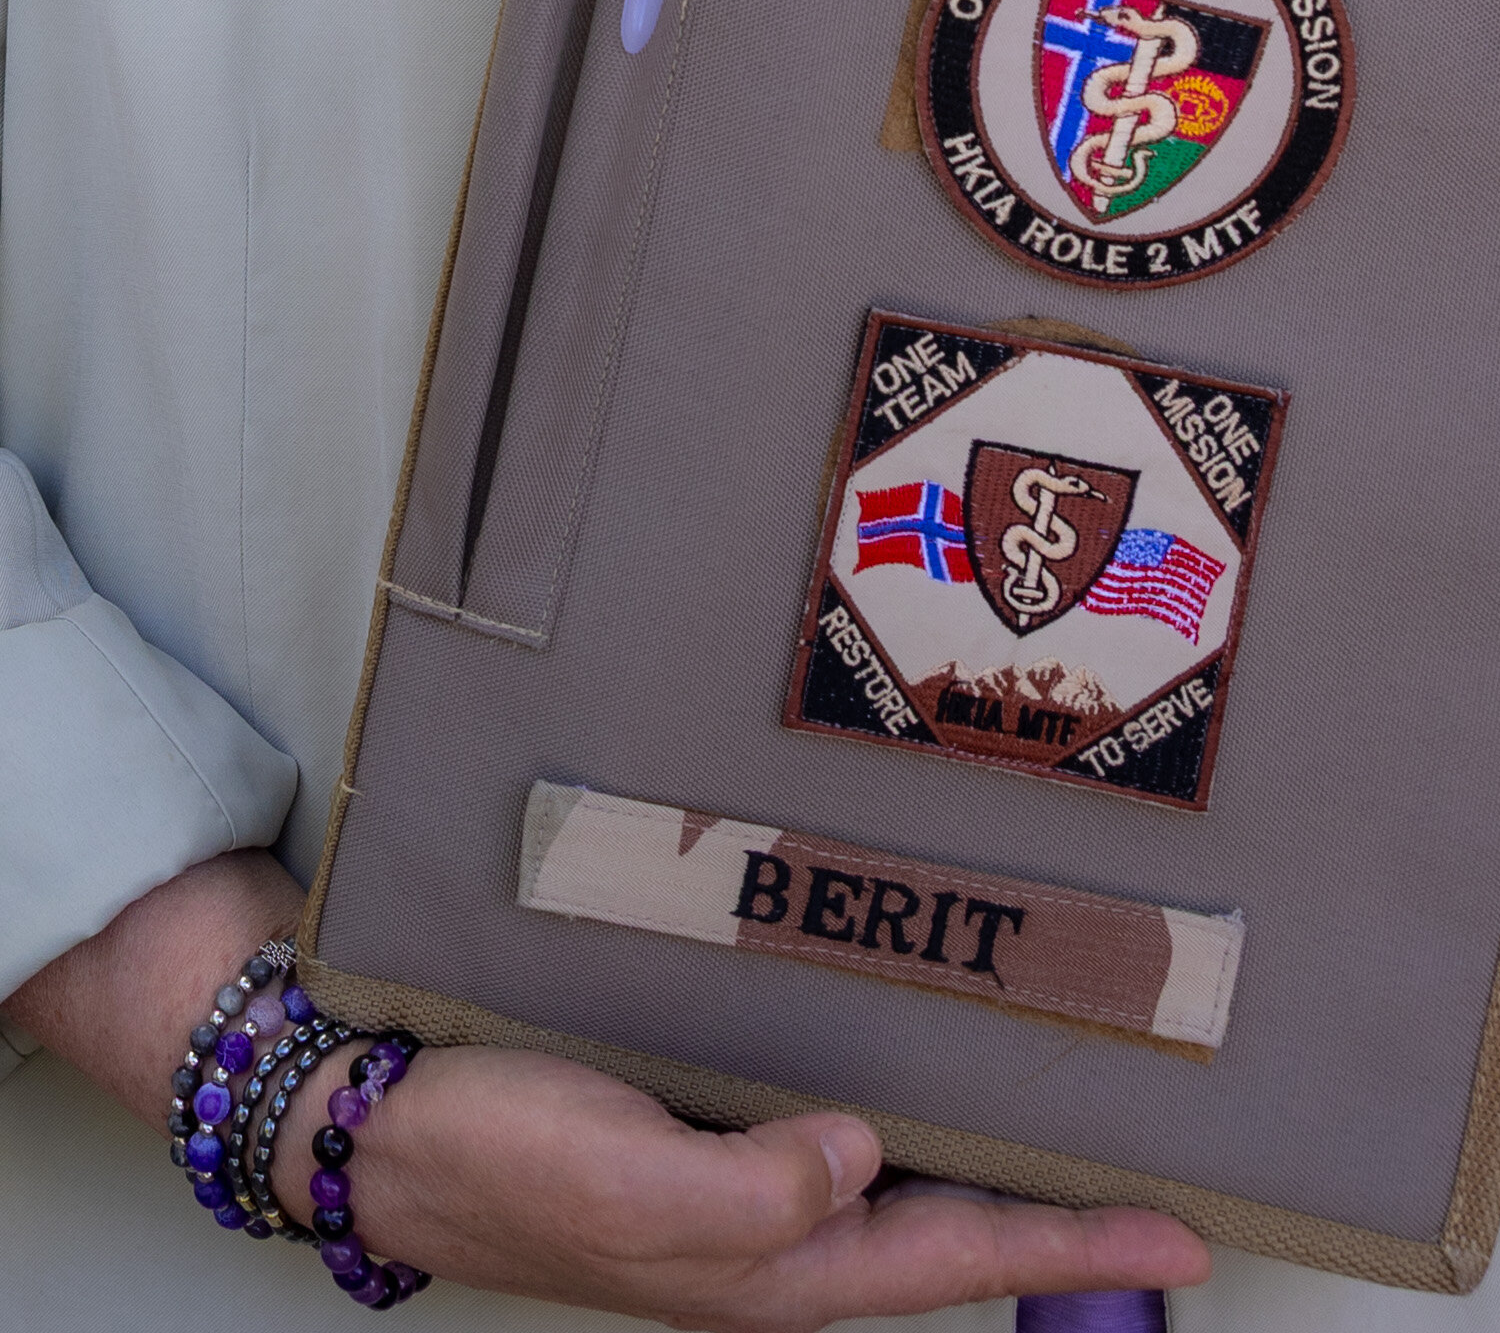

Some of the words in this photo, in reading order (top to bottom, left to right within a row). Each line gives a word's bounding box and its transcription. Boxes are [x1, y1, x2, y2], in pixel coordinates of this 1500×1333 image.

[944, 132, 1017, 226] HKIA
[1021, 221, 1131, 275] ROLE
[1147, 242, 1171, 273] 2
[1182, 200, 1264, 266] MTF
[872, 333, 946, 393] ONE
[873, 351, 978, 432] TEAM
[1153, 379, 1253, 513] MISSION
[1203, 394, 1262, 467] ONE
[819, 606, 918, 736] RESTORE
[730, 849, 1026, 985] BERIT
